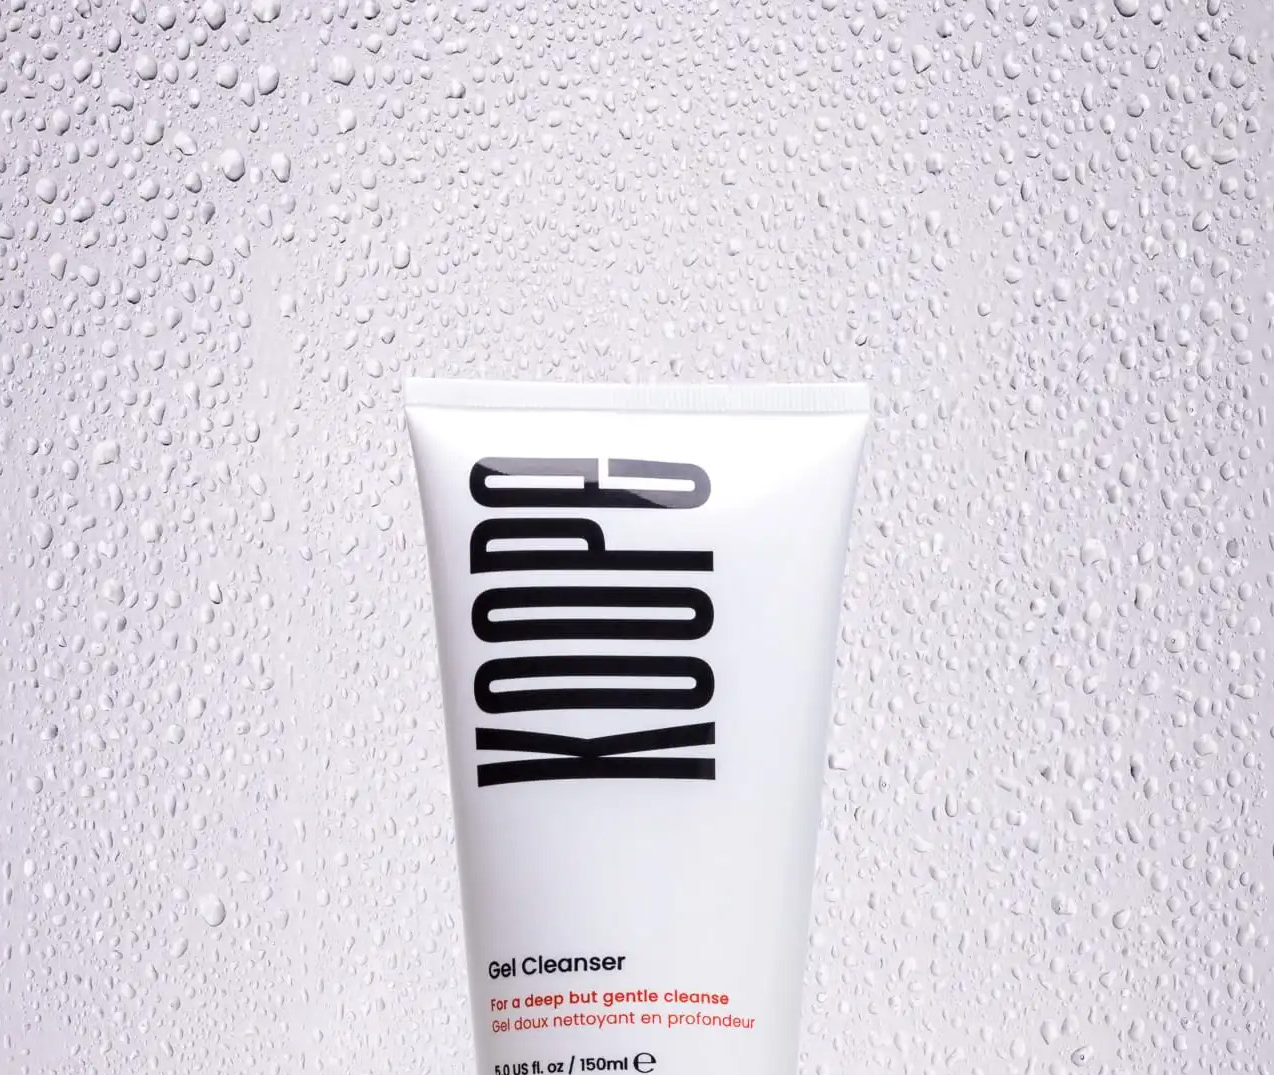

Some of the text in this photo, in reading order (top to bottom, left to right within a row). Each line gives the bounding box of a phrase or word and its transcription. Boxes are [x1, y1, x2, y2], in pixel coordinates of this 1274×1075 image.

[488, 954, 626, 979] Gel Cleanser
[491, 990, 729, 1011] For a deep but gentle cleanse
[492, 1012, 755, 1032] Gel doux nettoyant en profondeur
[513, 1063, 528, 1075] US
[532, 1061, 543, 1074] fl.
[548, 1062, 564, 1074] oz
[580, 1058, 628, 1072] 150ml
